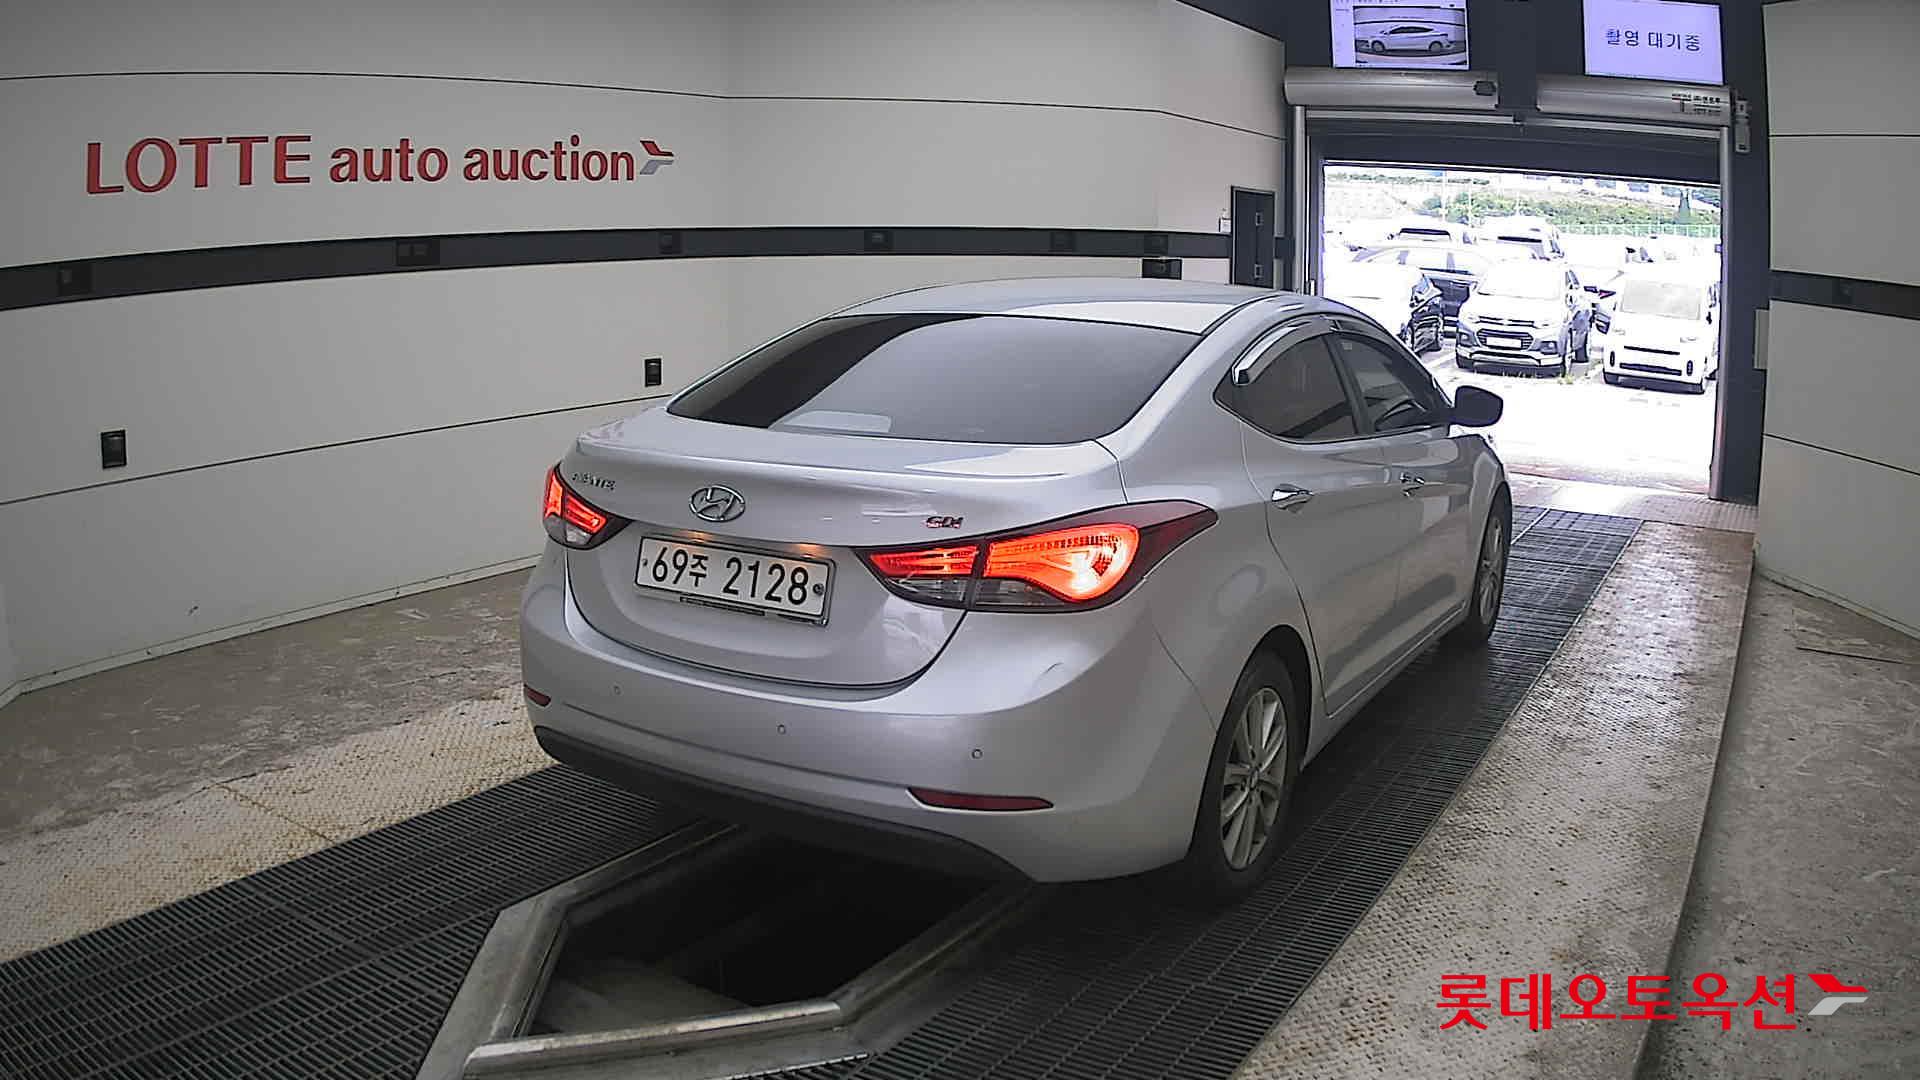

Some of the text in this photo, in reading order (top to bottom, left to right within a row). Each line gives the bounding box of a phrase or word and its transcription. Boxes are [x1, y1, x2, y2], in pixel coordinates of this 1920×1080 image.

[86, 134, 635, 195] LOTTE auto auction
[652, 547, 809, 605] 69주 2128
